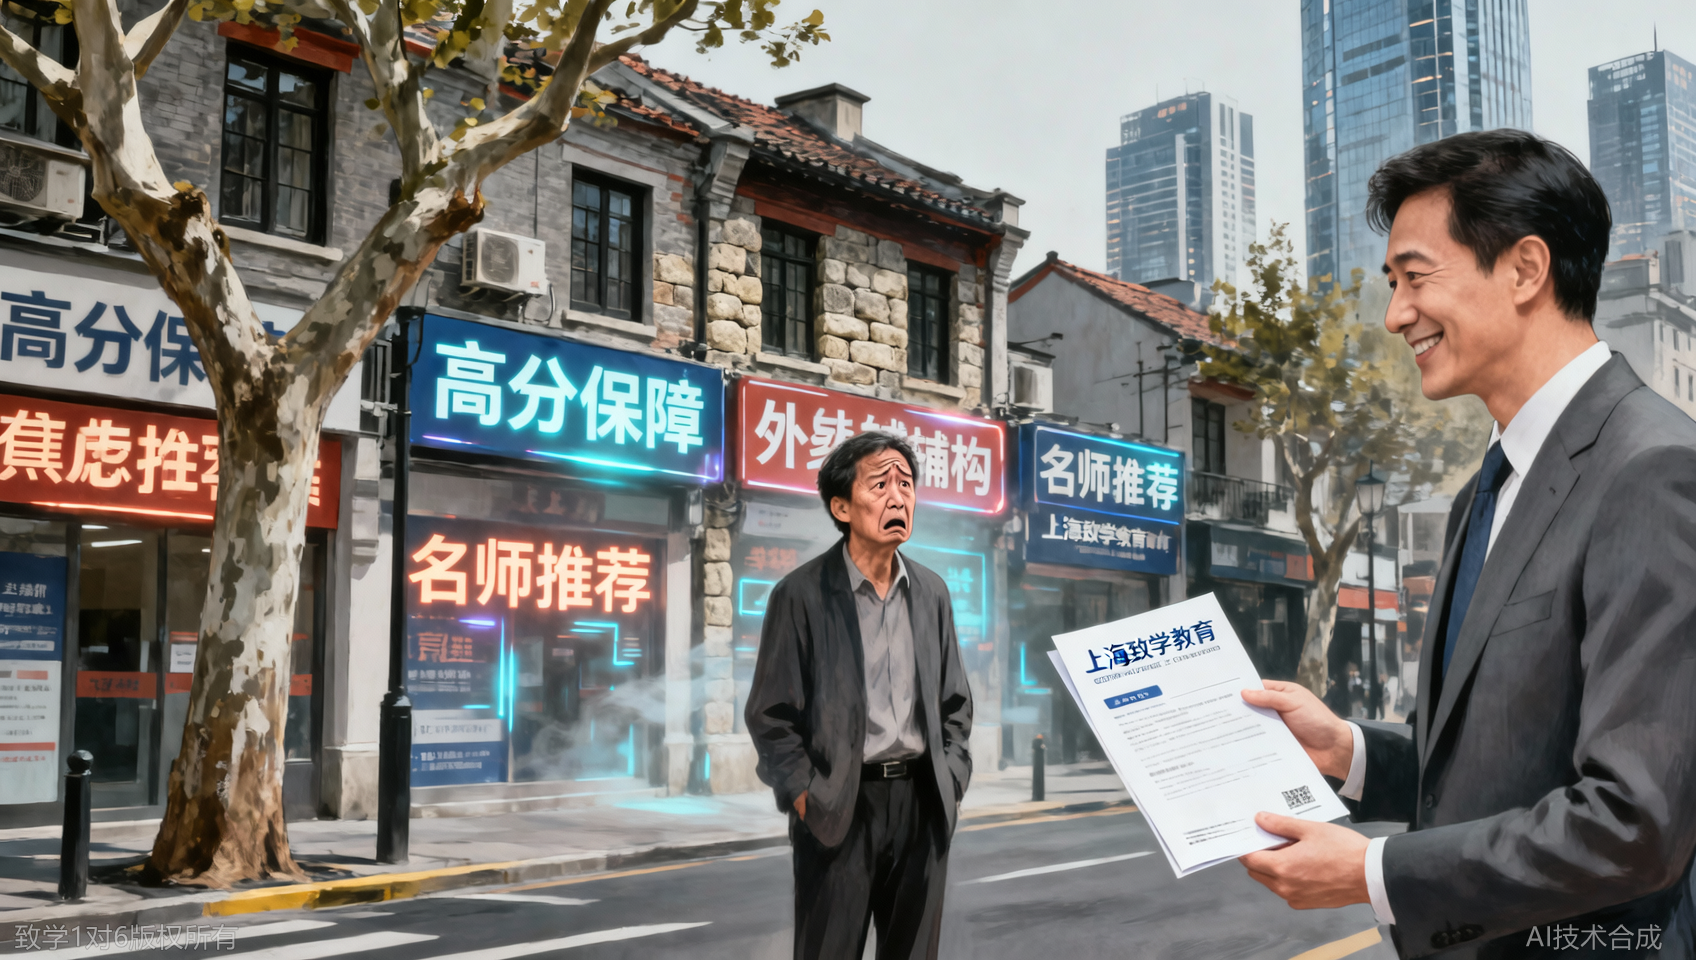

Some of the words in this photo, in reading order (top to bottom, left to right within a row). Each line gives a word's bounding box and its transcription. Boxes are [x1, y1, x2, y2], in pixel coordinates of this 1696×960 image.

[0, 290, 287, 387] 高分保
[435, 340, 705, 455] 高分保障
[1039, 443, 1179, 511] 名师推荐
[408, 533, 651, 613] 名师推荐
[1086, 620, 1216, 674] 上海致学教育
